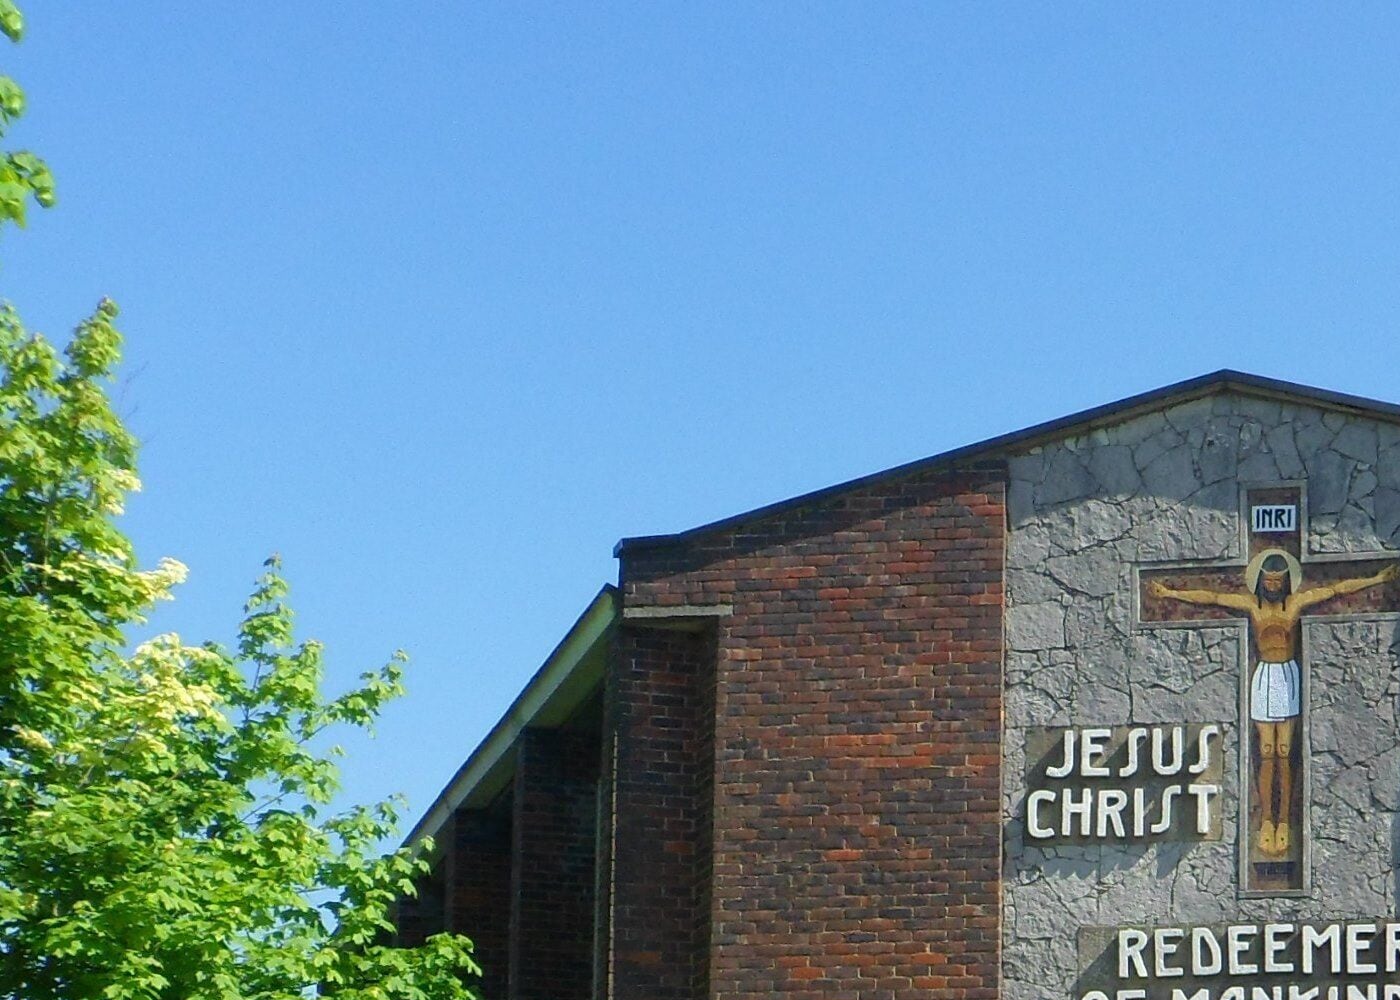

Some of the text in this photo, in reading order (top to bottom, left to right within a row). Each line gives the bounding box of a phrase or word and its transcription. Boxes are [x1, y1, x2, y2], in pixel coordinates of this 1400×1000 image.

[1256, 508, 1292, 529] INRI
[1045, 724, 1219, 777] JESUS
[1026, 783, 1219, 838] CHRIST
